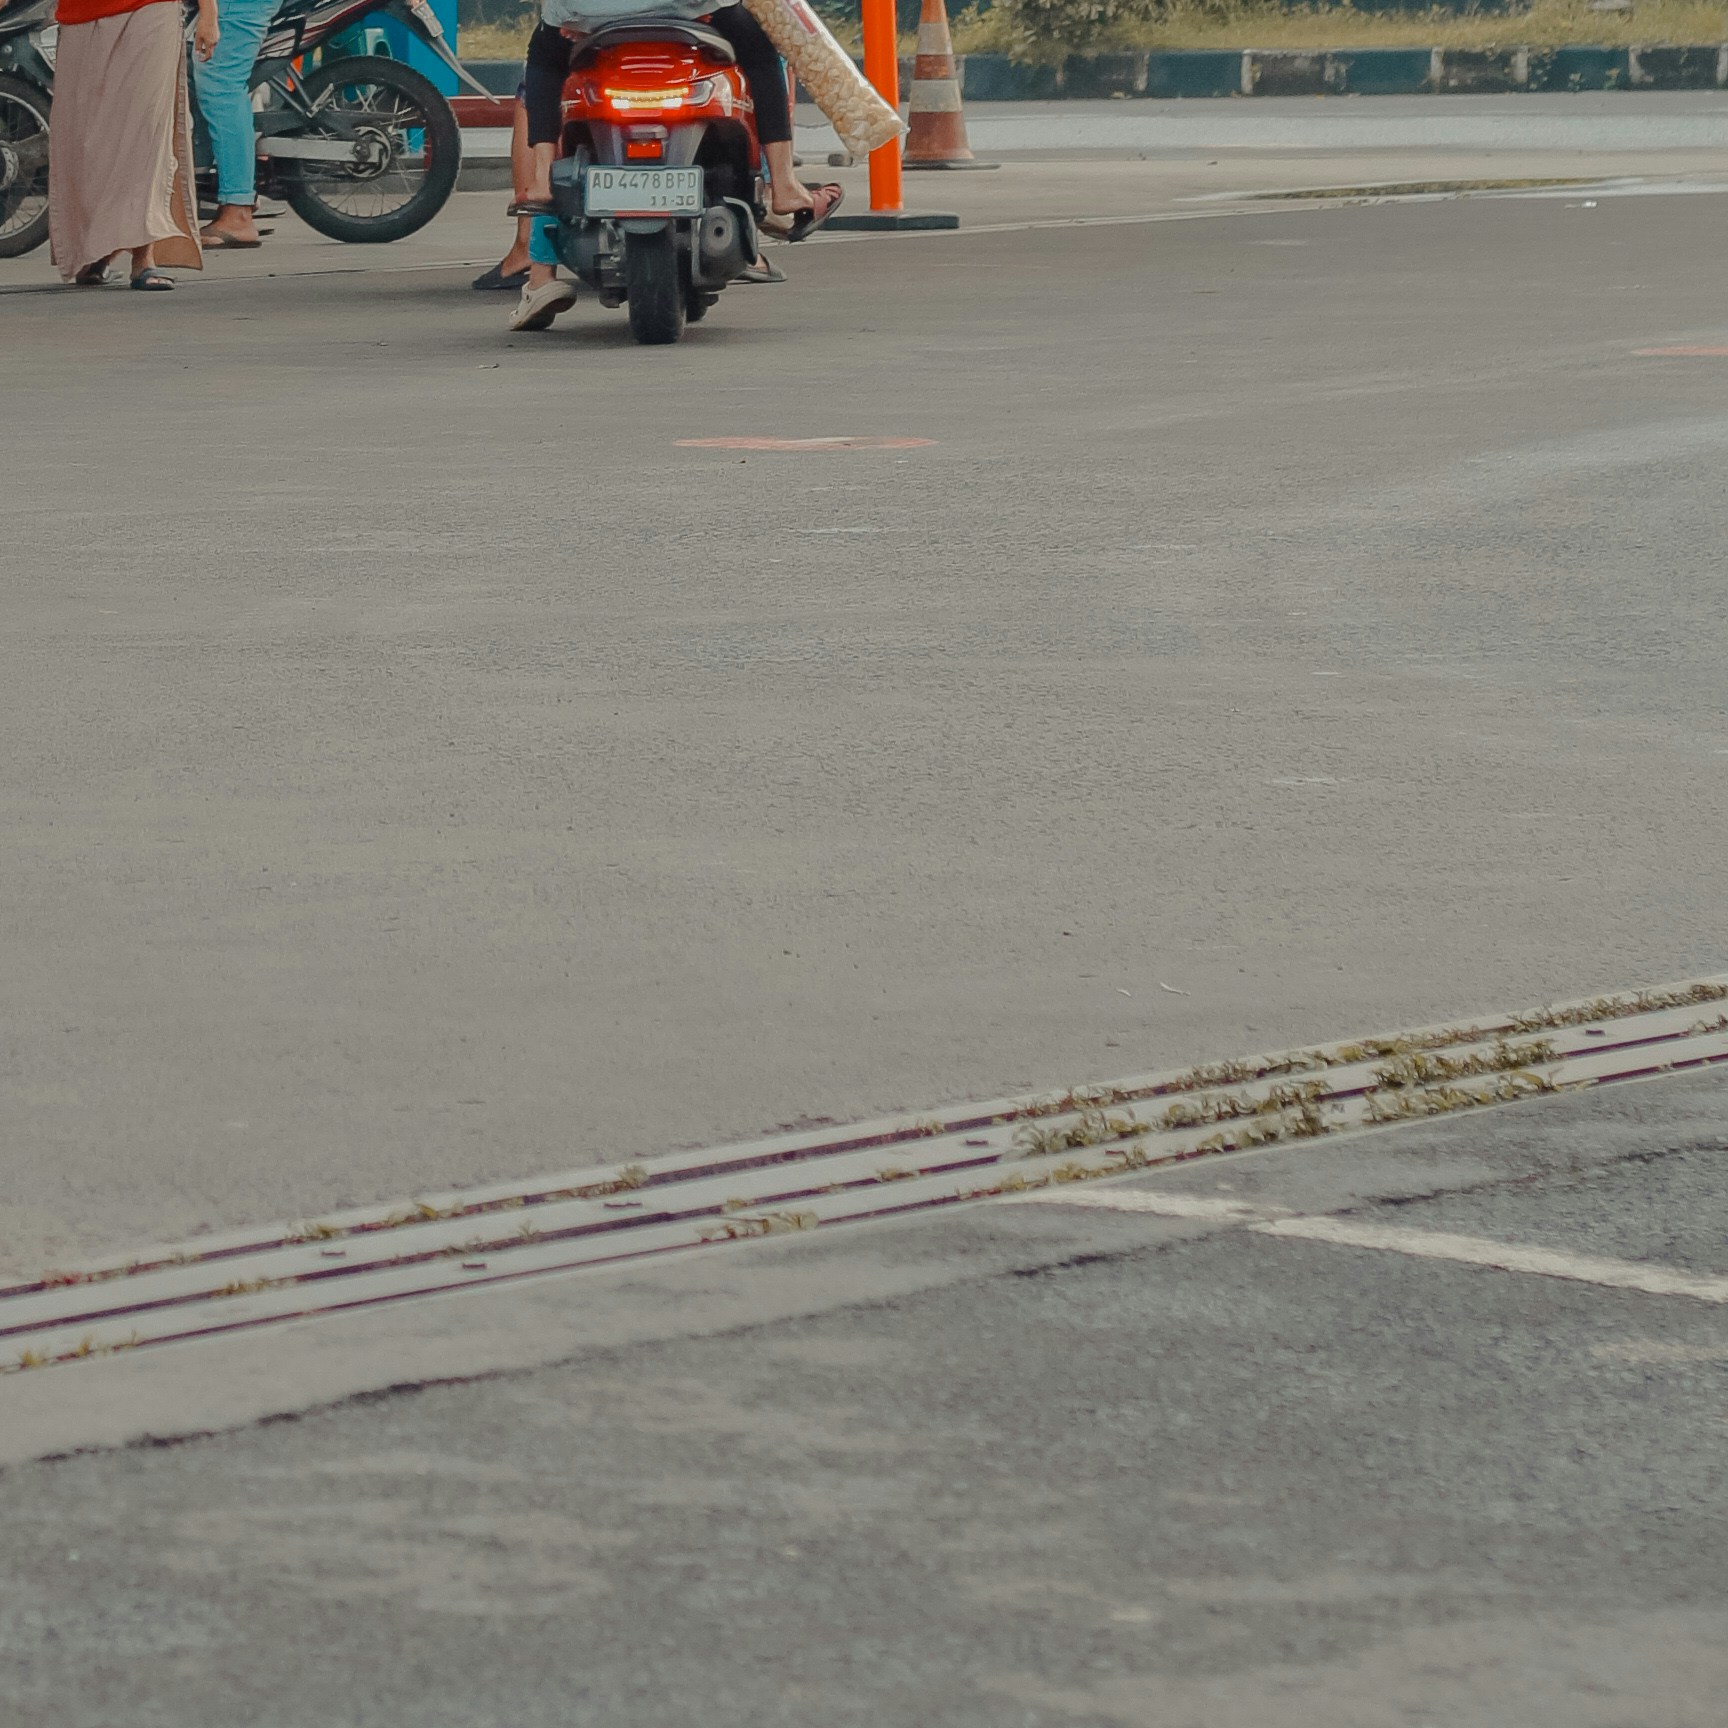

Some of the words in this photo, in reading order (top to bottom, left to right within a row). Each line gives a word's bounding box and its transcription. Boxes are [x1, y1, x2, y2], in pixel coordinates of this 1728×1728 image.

[592, 173, 614, 189] AD
[618, 173, 661, 189] 4478
[665, 172, 697, 189] BPD
